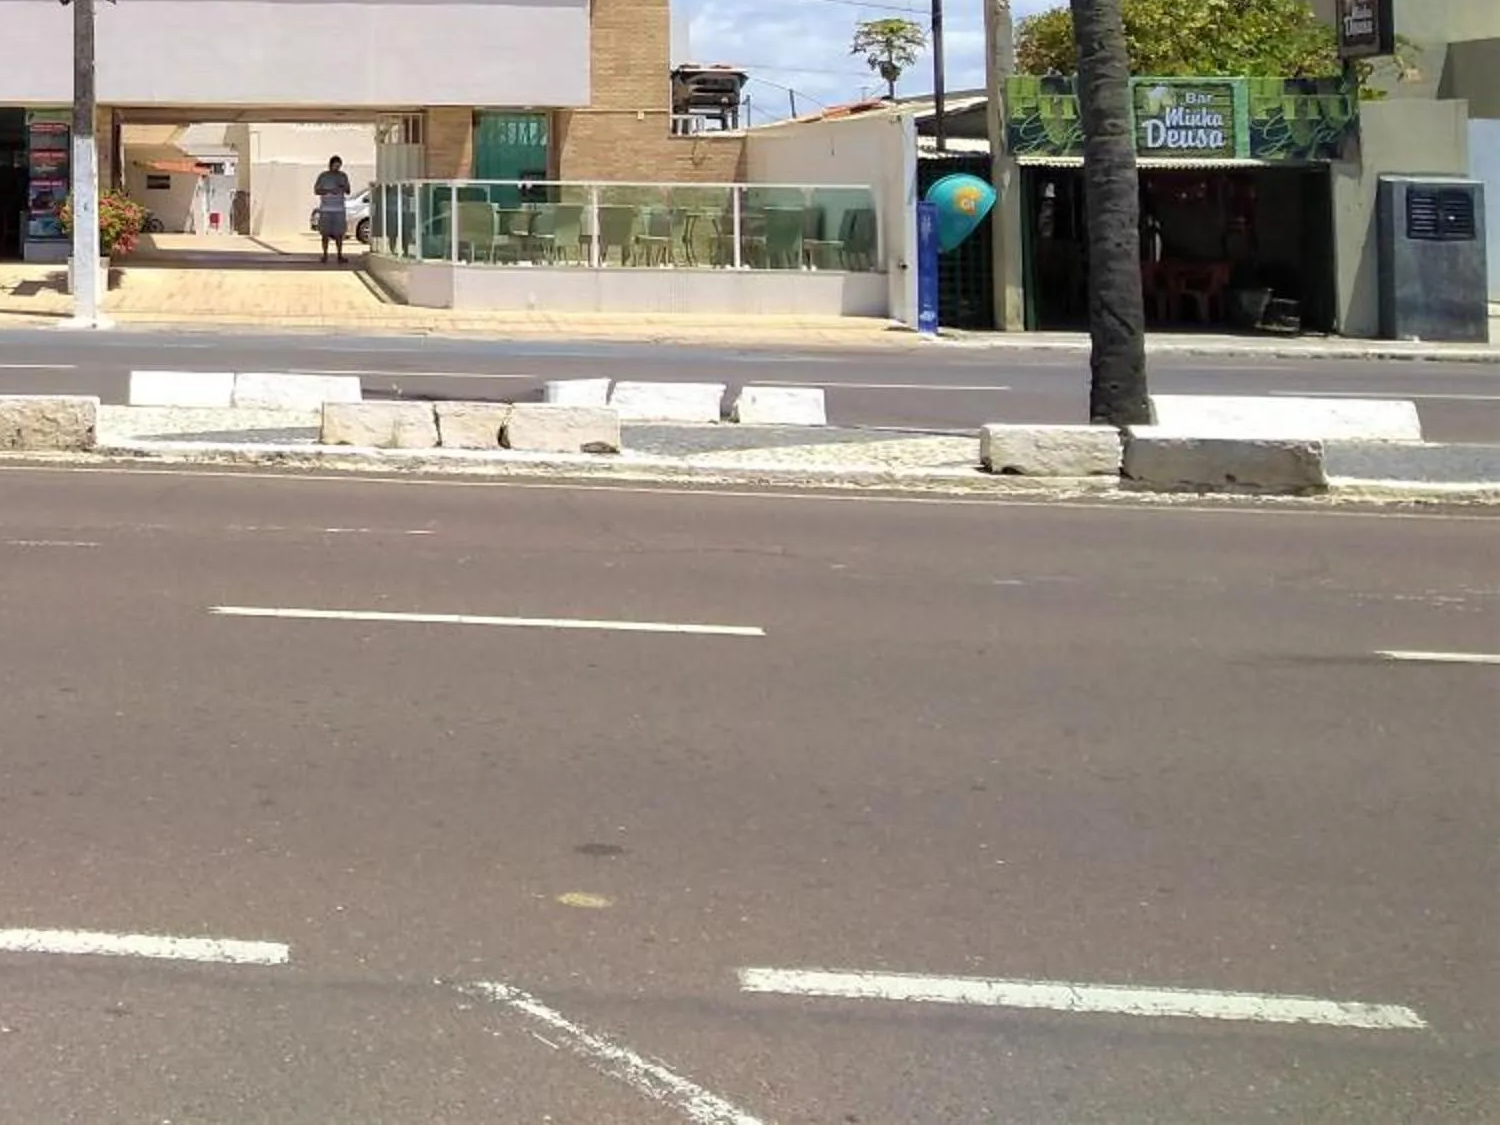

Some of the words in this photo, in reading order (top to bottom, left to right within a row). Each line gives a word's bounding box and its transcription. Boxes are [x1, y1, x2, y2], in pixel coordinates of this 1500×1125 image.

[1185, 92, 1214, 104] Bar
[1164, 106, 1223, 127] Minha
[1142, 118, 1225, 149] Deusa
